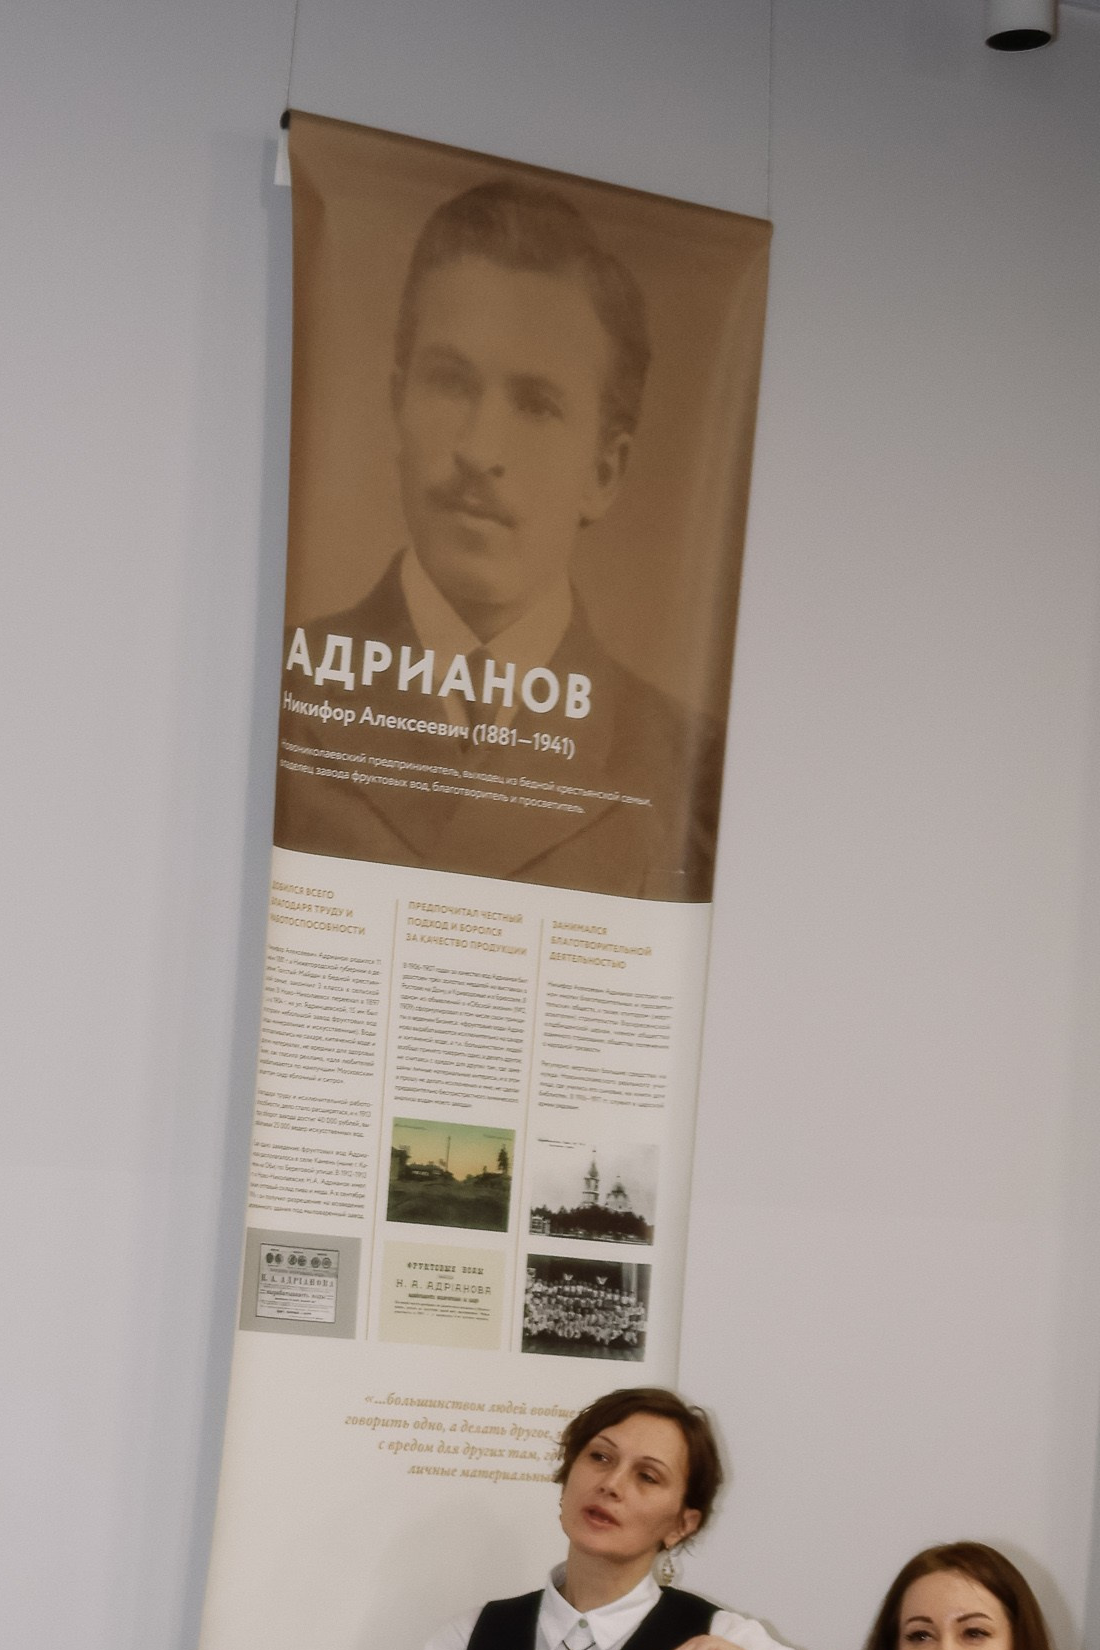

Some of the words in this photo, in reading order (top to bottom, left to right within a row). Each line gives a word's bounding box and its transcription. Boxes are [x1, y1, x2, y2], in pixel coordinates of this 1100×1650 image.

[285, 627, 592, 719] АДРИАНОВ
[283, 689, 354, 726] Никифор
[360, 706, 470, 739] Алексеевич
[316, 767, 350, 780] завода
[352, 770, 409, 787] фруктовых
[520, 776, 556, 791] бедной
[307, 887, 334, 900] ВСЕГО
[315, 904, 344, 917] ТРУДУ
[346, 909, 354, 918] И
[409, 900, 479, 917] ПРЕДПОЧИТАЛ
[481, 911, 524, 923] ЧЕСТНЫЙ
[408, 916, 450, 931] ПОДХОД
[460, 923, 503, 937] БОРОЛСЯ
[406, 932, 419, 942] ЗА
[420, 935, 468, 949] КАЧЕСТВО
[470, 940, 528, 956] ПРОДУКЦИИ
[345, 1416, 410, 1431] говорить
[413, 1417, 446, 1432] одно,
[450, 1423, 457, 1432] а
[461, 1420, 507, 1436] делать
[379, 1441, 385, 1450] с
[388, 1439, 435, 1455] вредом
[437, 1440, 460, 1455] для
[463, 1442, 506, 1460] других
[407, 1465, 458, 1477] личные
